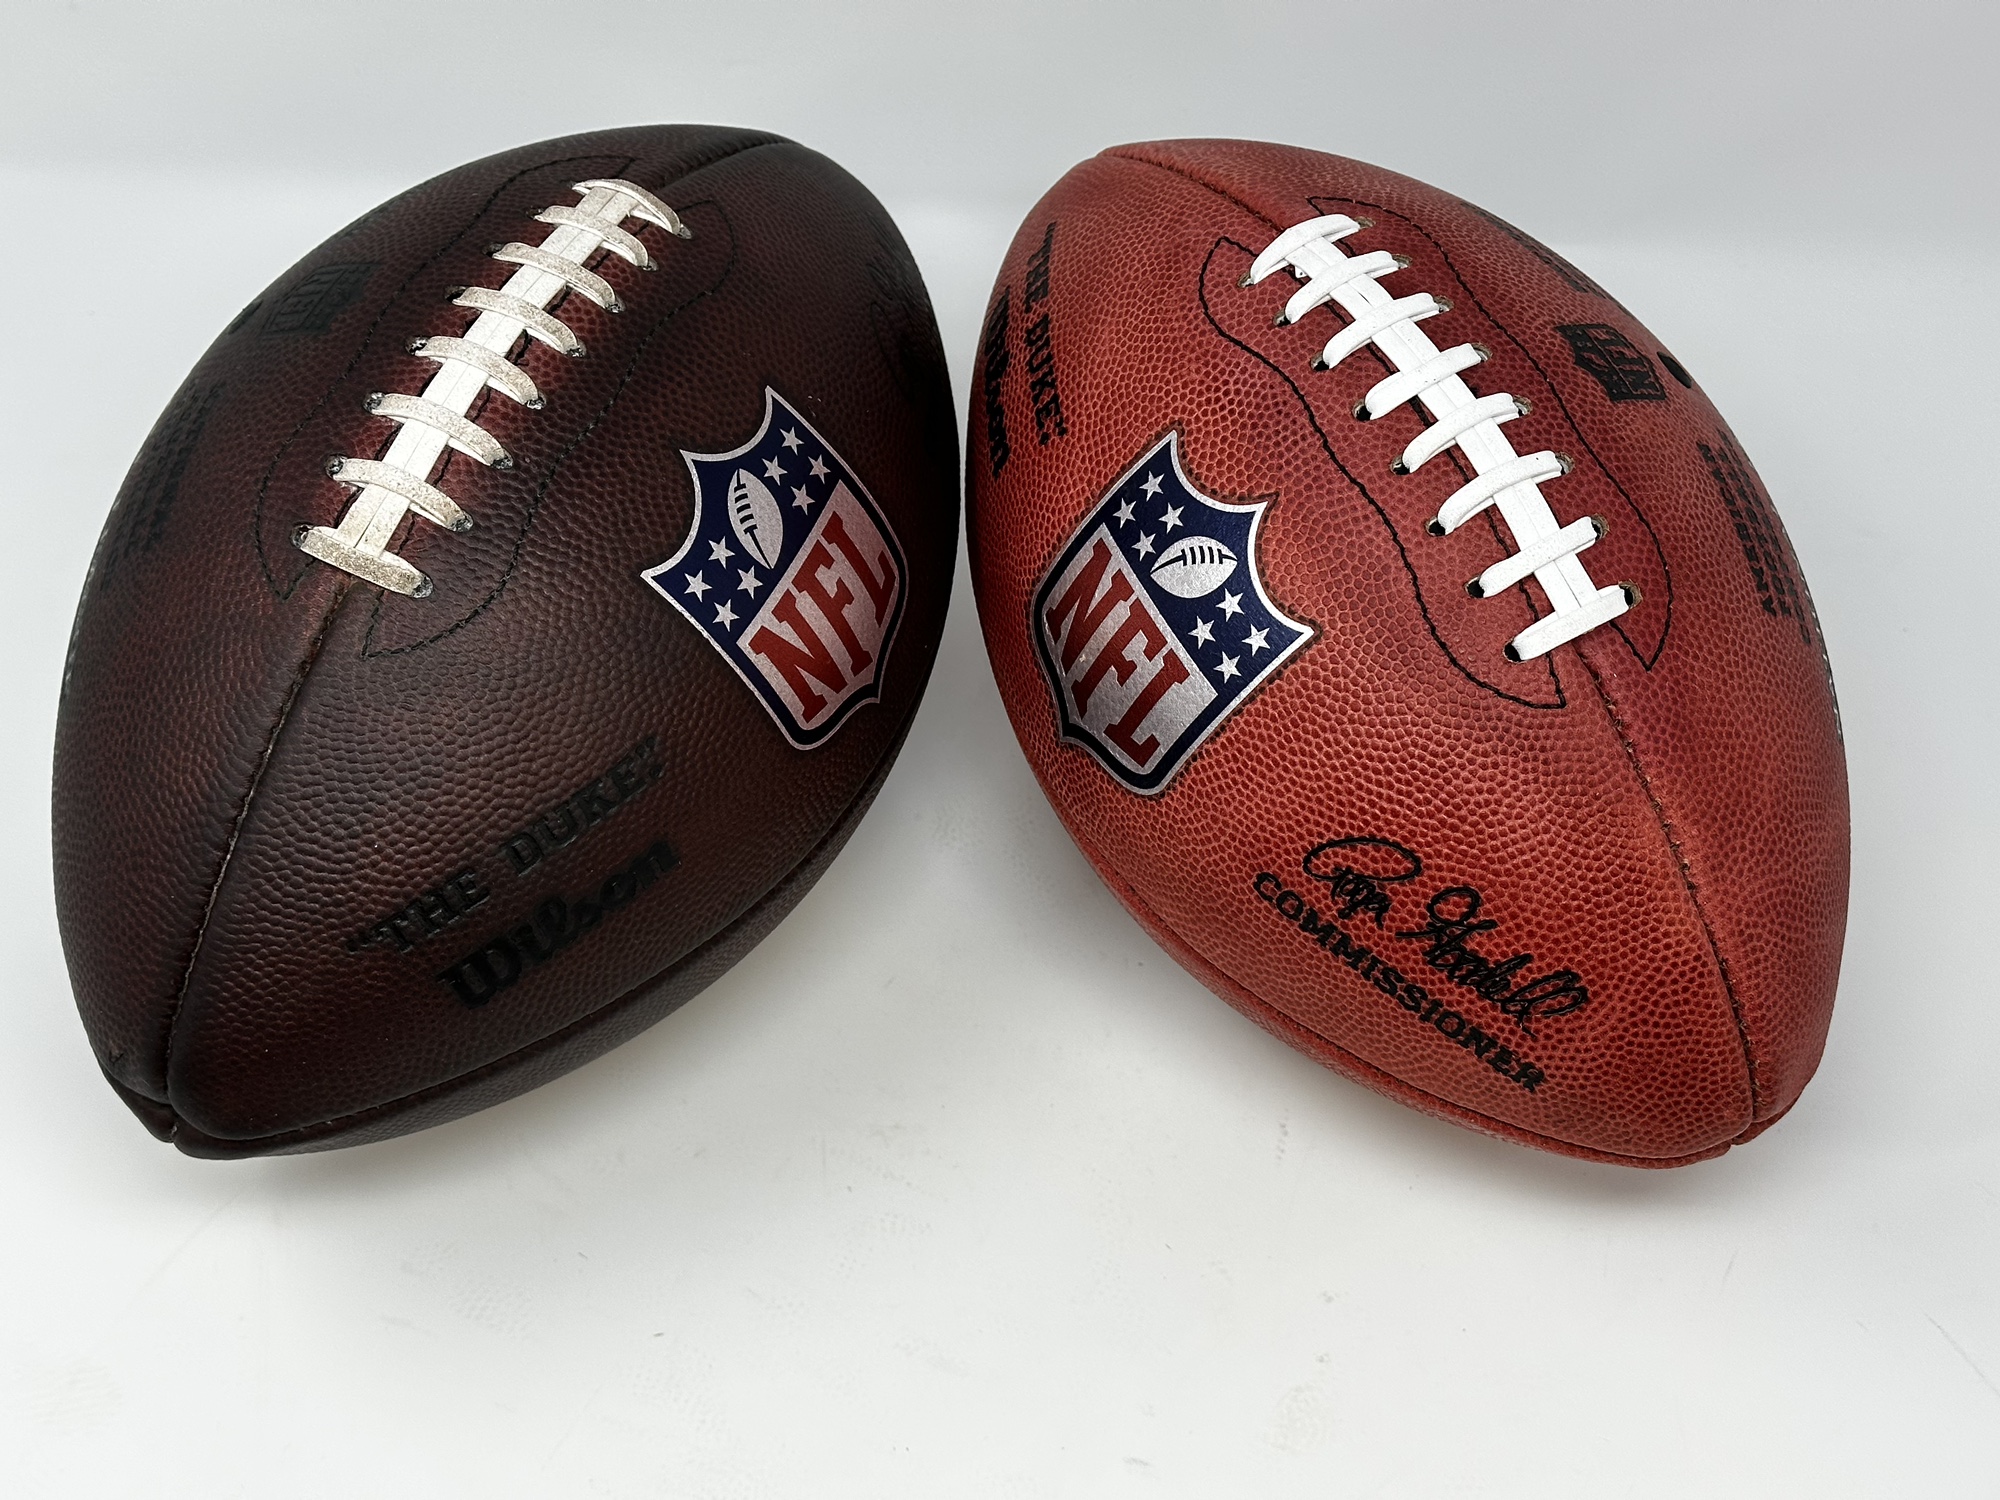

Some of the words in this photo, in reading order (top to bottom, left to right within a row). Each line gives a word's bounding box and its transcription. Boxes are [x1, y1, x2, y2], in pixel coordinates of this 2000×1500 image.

[749, 510, 897, 724] NFL
[1046, 537, 1191, 768] NFL
[436, 840, 681, 1010] Wilson
[1252, 872, 1546, 1093] COMMISSIONER
